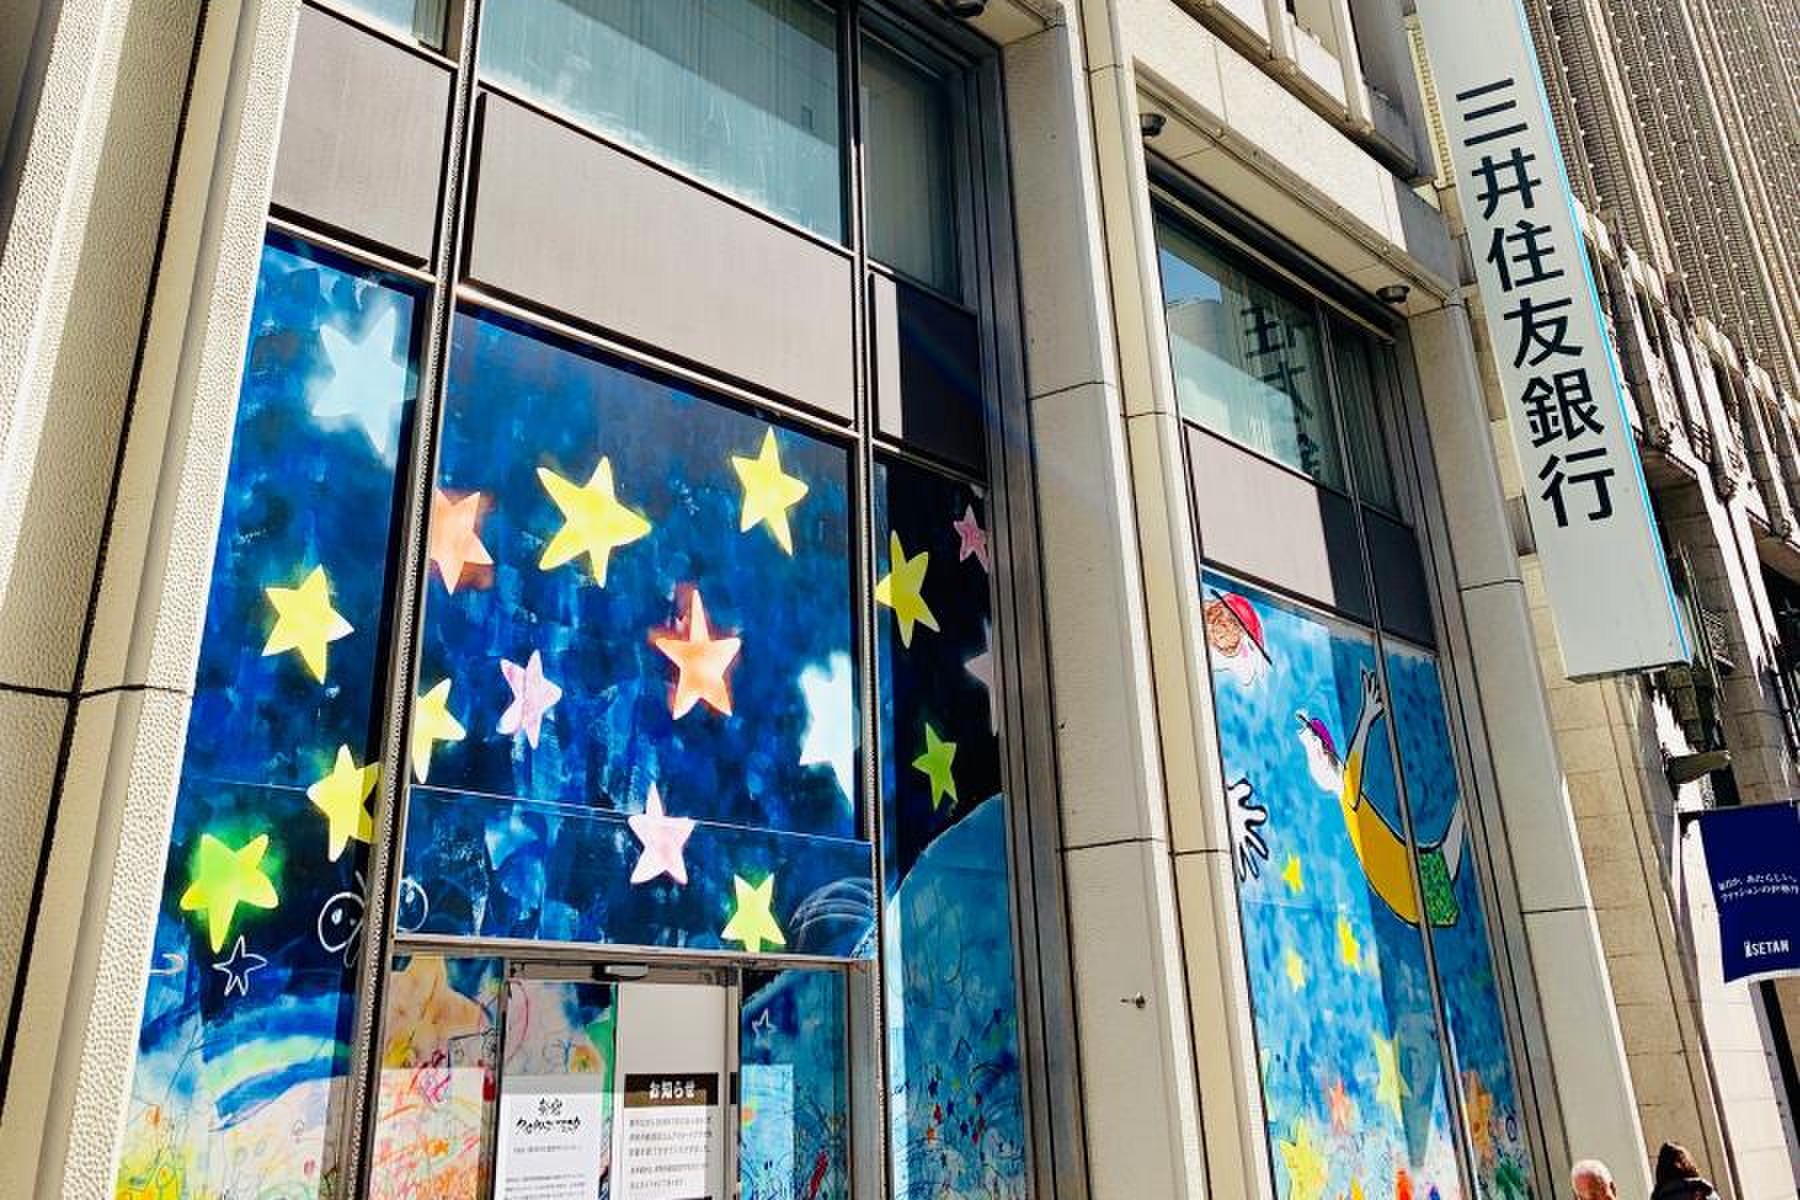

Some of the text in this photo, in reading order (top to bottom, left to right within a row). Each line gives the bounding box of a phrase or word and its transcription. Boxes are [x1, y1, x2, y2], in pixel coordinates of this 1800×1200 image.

[1455, 77, 1616, 528] 三井住友銀行
[1743, 939, 1790, 959] ISETAN
[649, 1079, 696, 1100] お知らせ
